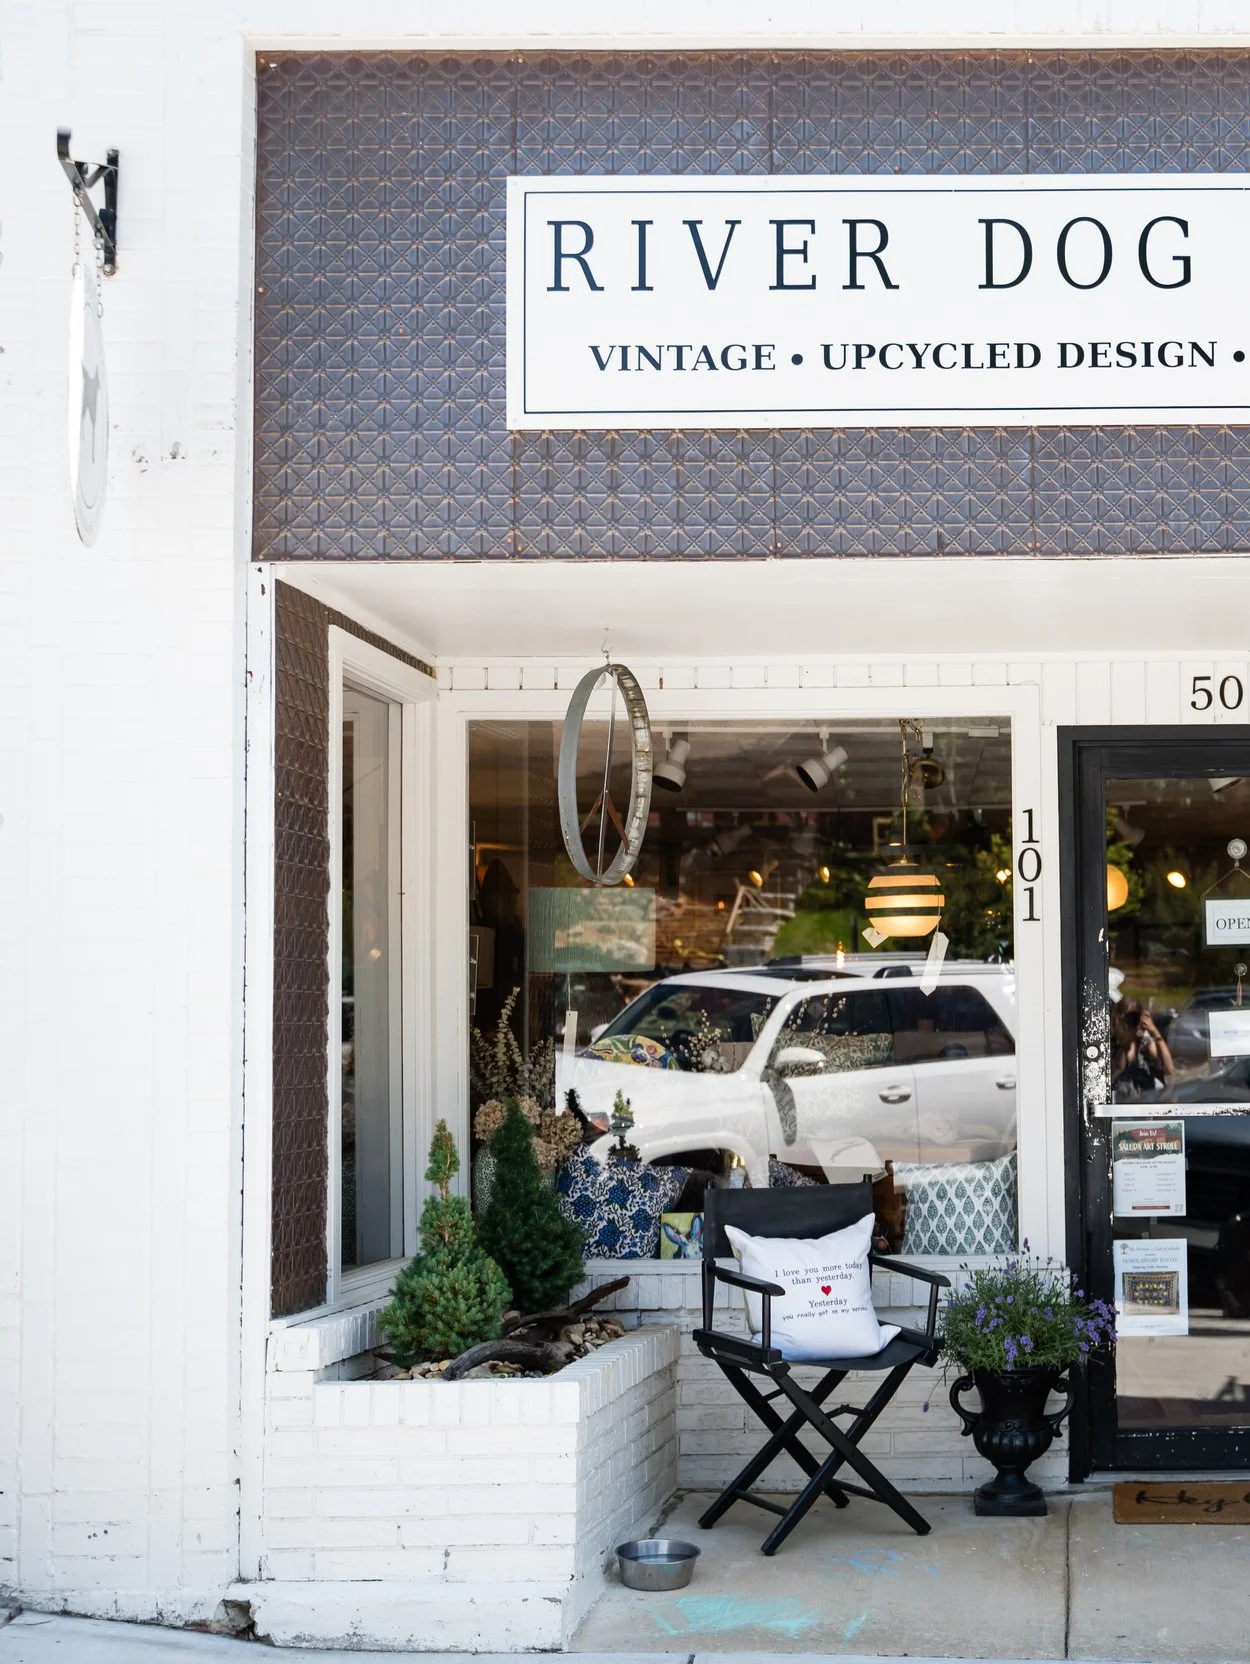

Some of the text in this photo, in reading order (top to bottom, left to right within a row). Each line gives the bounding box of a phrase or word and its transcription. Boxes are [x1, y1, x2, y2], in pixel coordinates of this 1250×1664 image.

[547, 219, 899, 291] RIVER
[978, 216, 1191, 289] DOG
[589, 345, 775, 371] VINTAGE
[821, 343, 1041, 369] UPCYCLED
[1057, 342, 1217, 368] DESIGN
[1190, 675, 1244, 710] 50
[1016, 808, 1043, 922] 101
[1143, 1142, 1156, 1151] ART
[1156, 1142, 1178, 1151] STROLL
[775, 1270, 779, 1278] I
[782, 1269, 800, 1277] love
[804, 1267, 819, 1276] you
[845, 1261, 863, 1270] today
[816, 1272, 855, 1284] yesterday.
[808, 1297, 848, 1308] Yesterday
